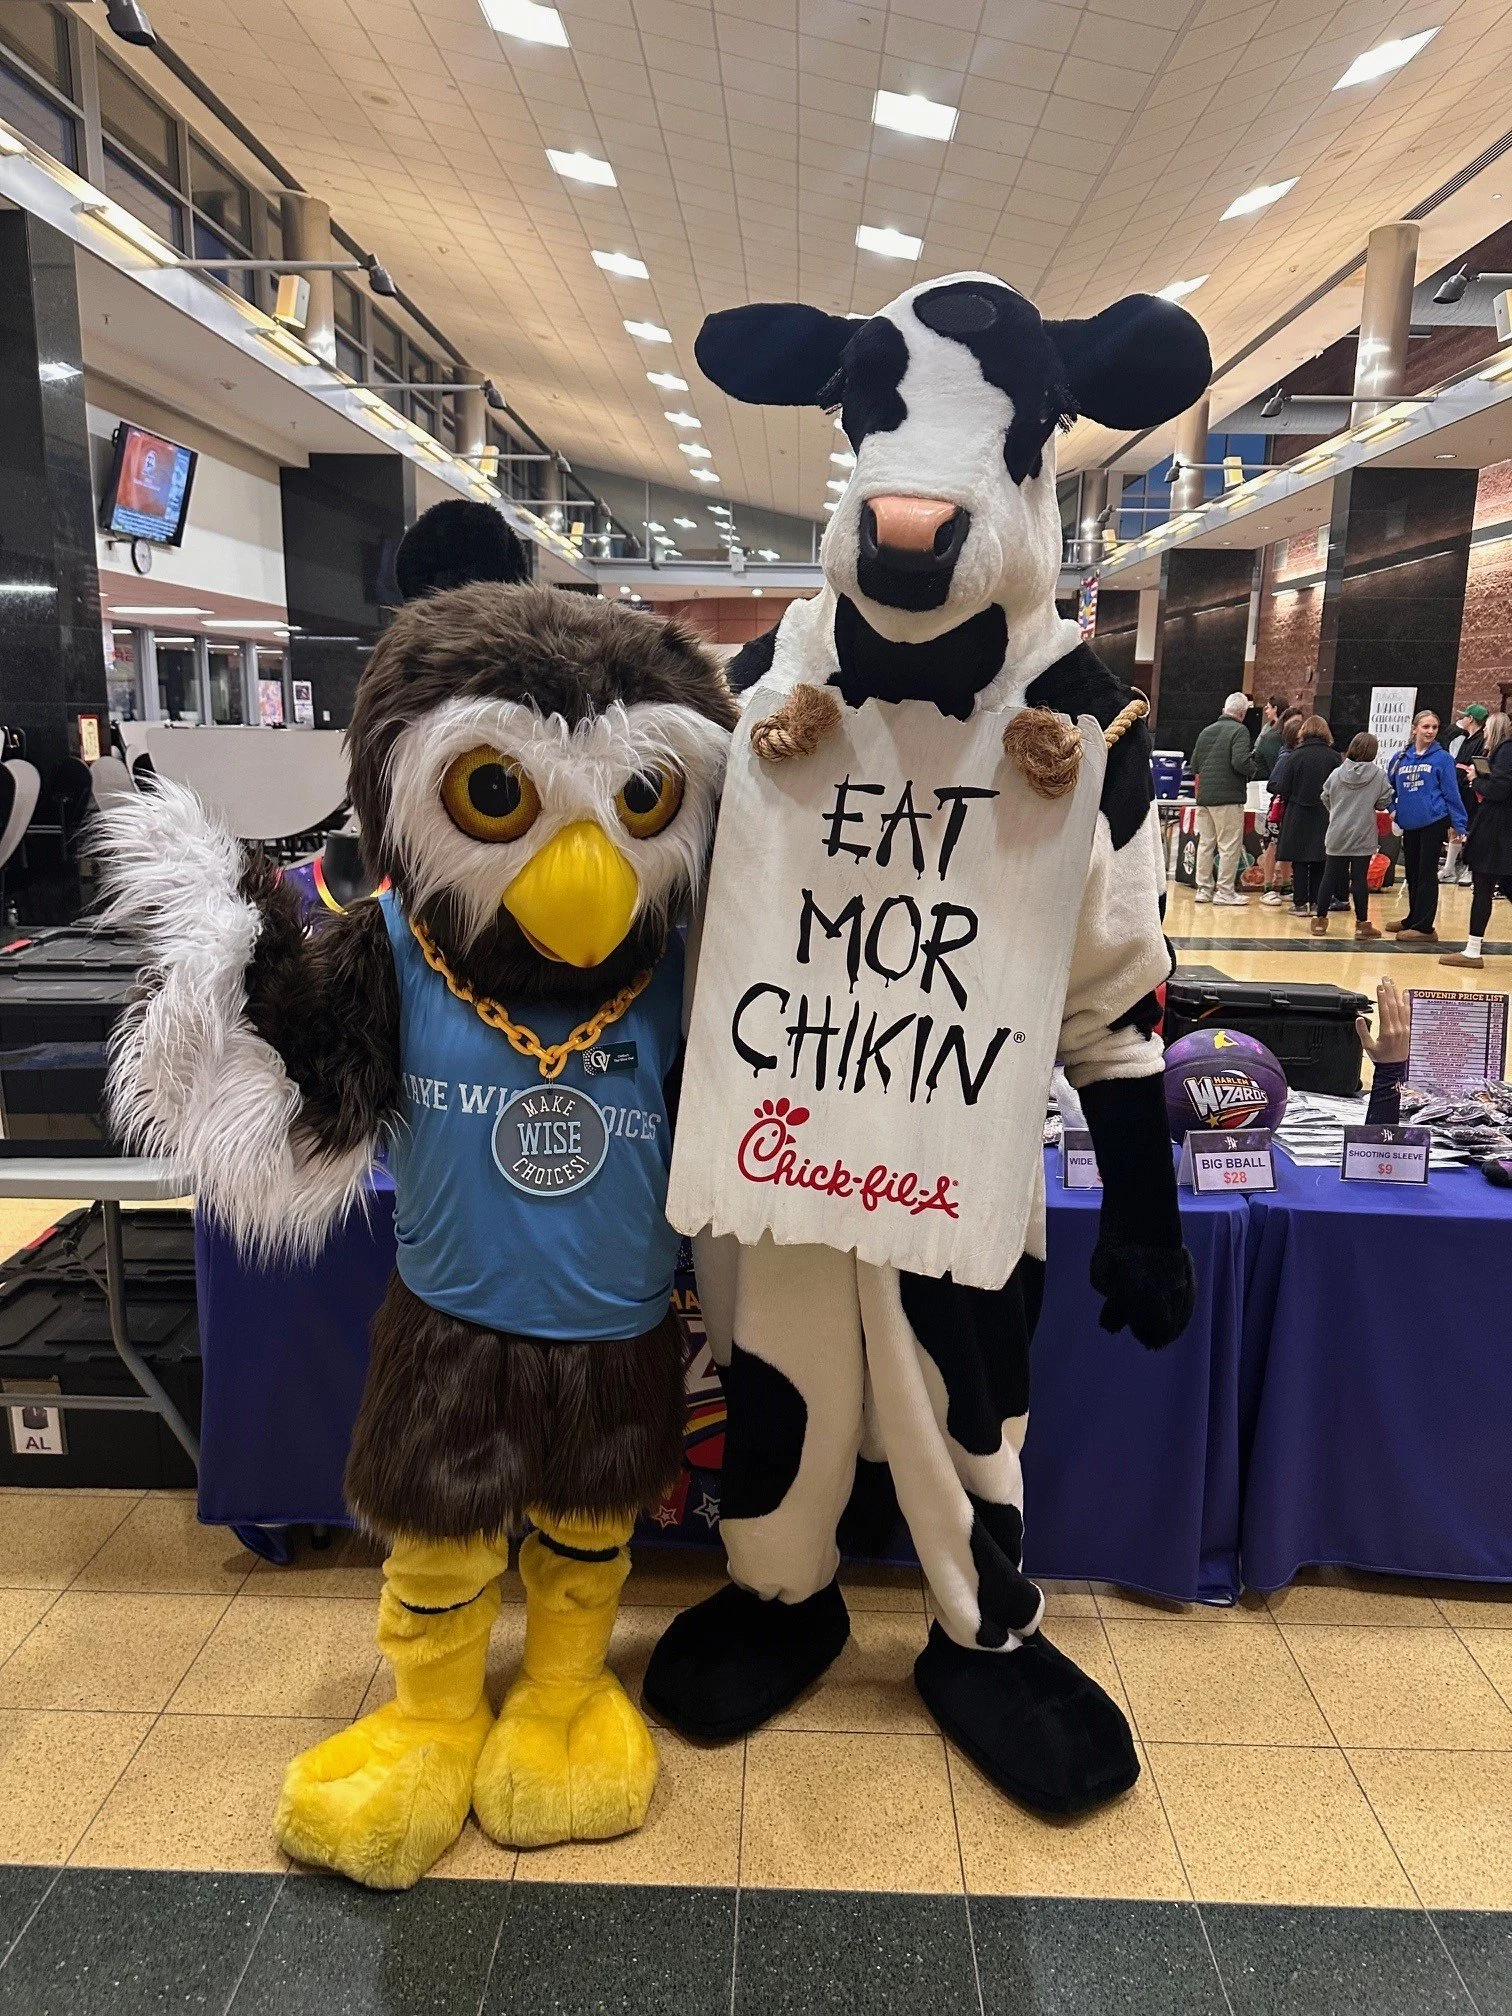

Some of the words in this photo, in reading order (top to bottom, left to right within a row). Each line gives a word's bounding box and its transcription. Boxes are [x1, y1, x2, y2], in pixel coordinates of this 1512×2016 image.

[821, 773, 1000, 881] EAT
[795, 888, 979, 1011] MOR
[1414, 990, 1456, 1000] SOUVENIR
[1486, 994, 1504, 1002] LIST
[1214, 1076, 1250, 1086] HARLEM
[458, 1083, 521, 1116] WI
[522, 1095, 575, 1118] MAKE
[517, 1121, 581, 1156] WISE
[1070, 1157, 1093, 1165] WIDE
[1348, 1150, 1390, 1159] SHOOTING
[1392, 1152, 1424, 1160] SLEEVE
[1202, 1159, 1222, 1169] BIG
[1226, 1158, 1266, 1168] BBALL
[1378, 1162, 1392, 1174] $9
[512, 1155, 590, 1186] CHOICES!
[1224, 1172, 1247, 1184] $28
[26, 1436, 52, 1450] AL
